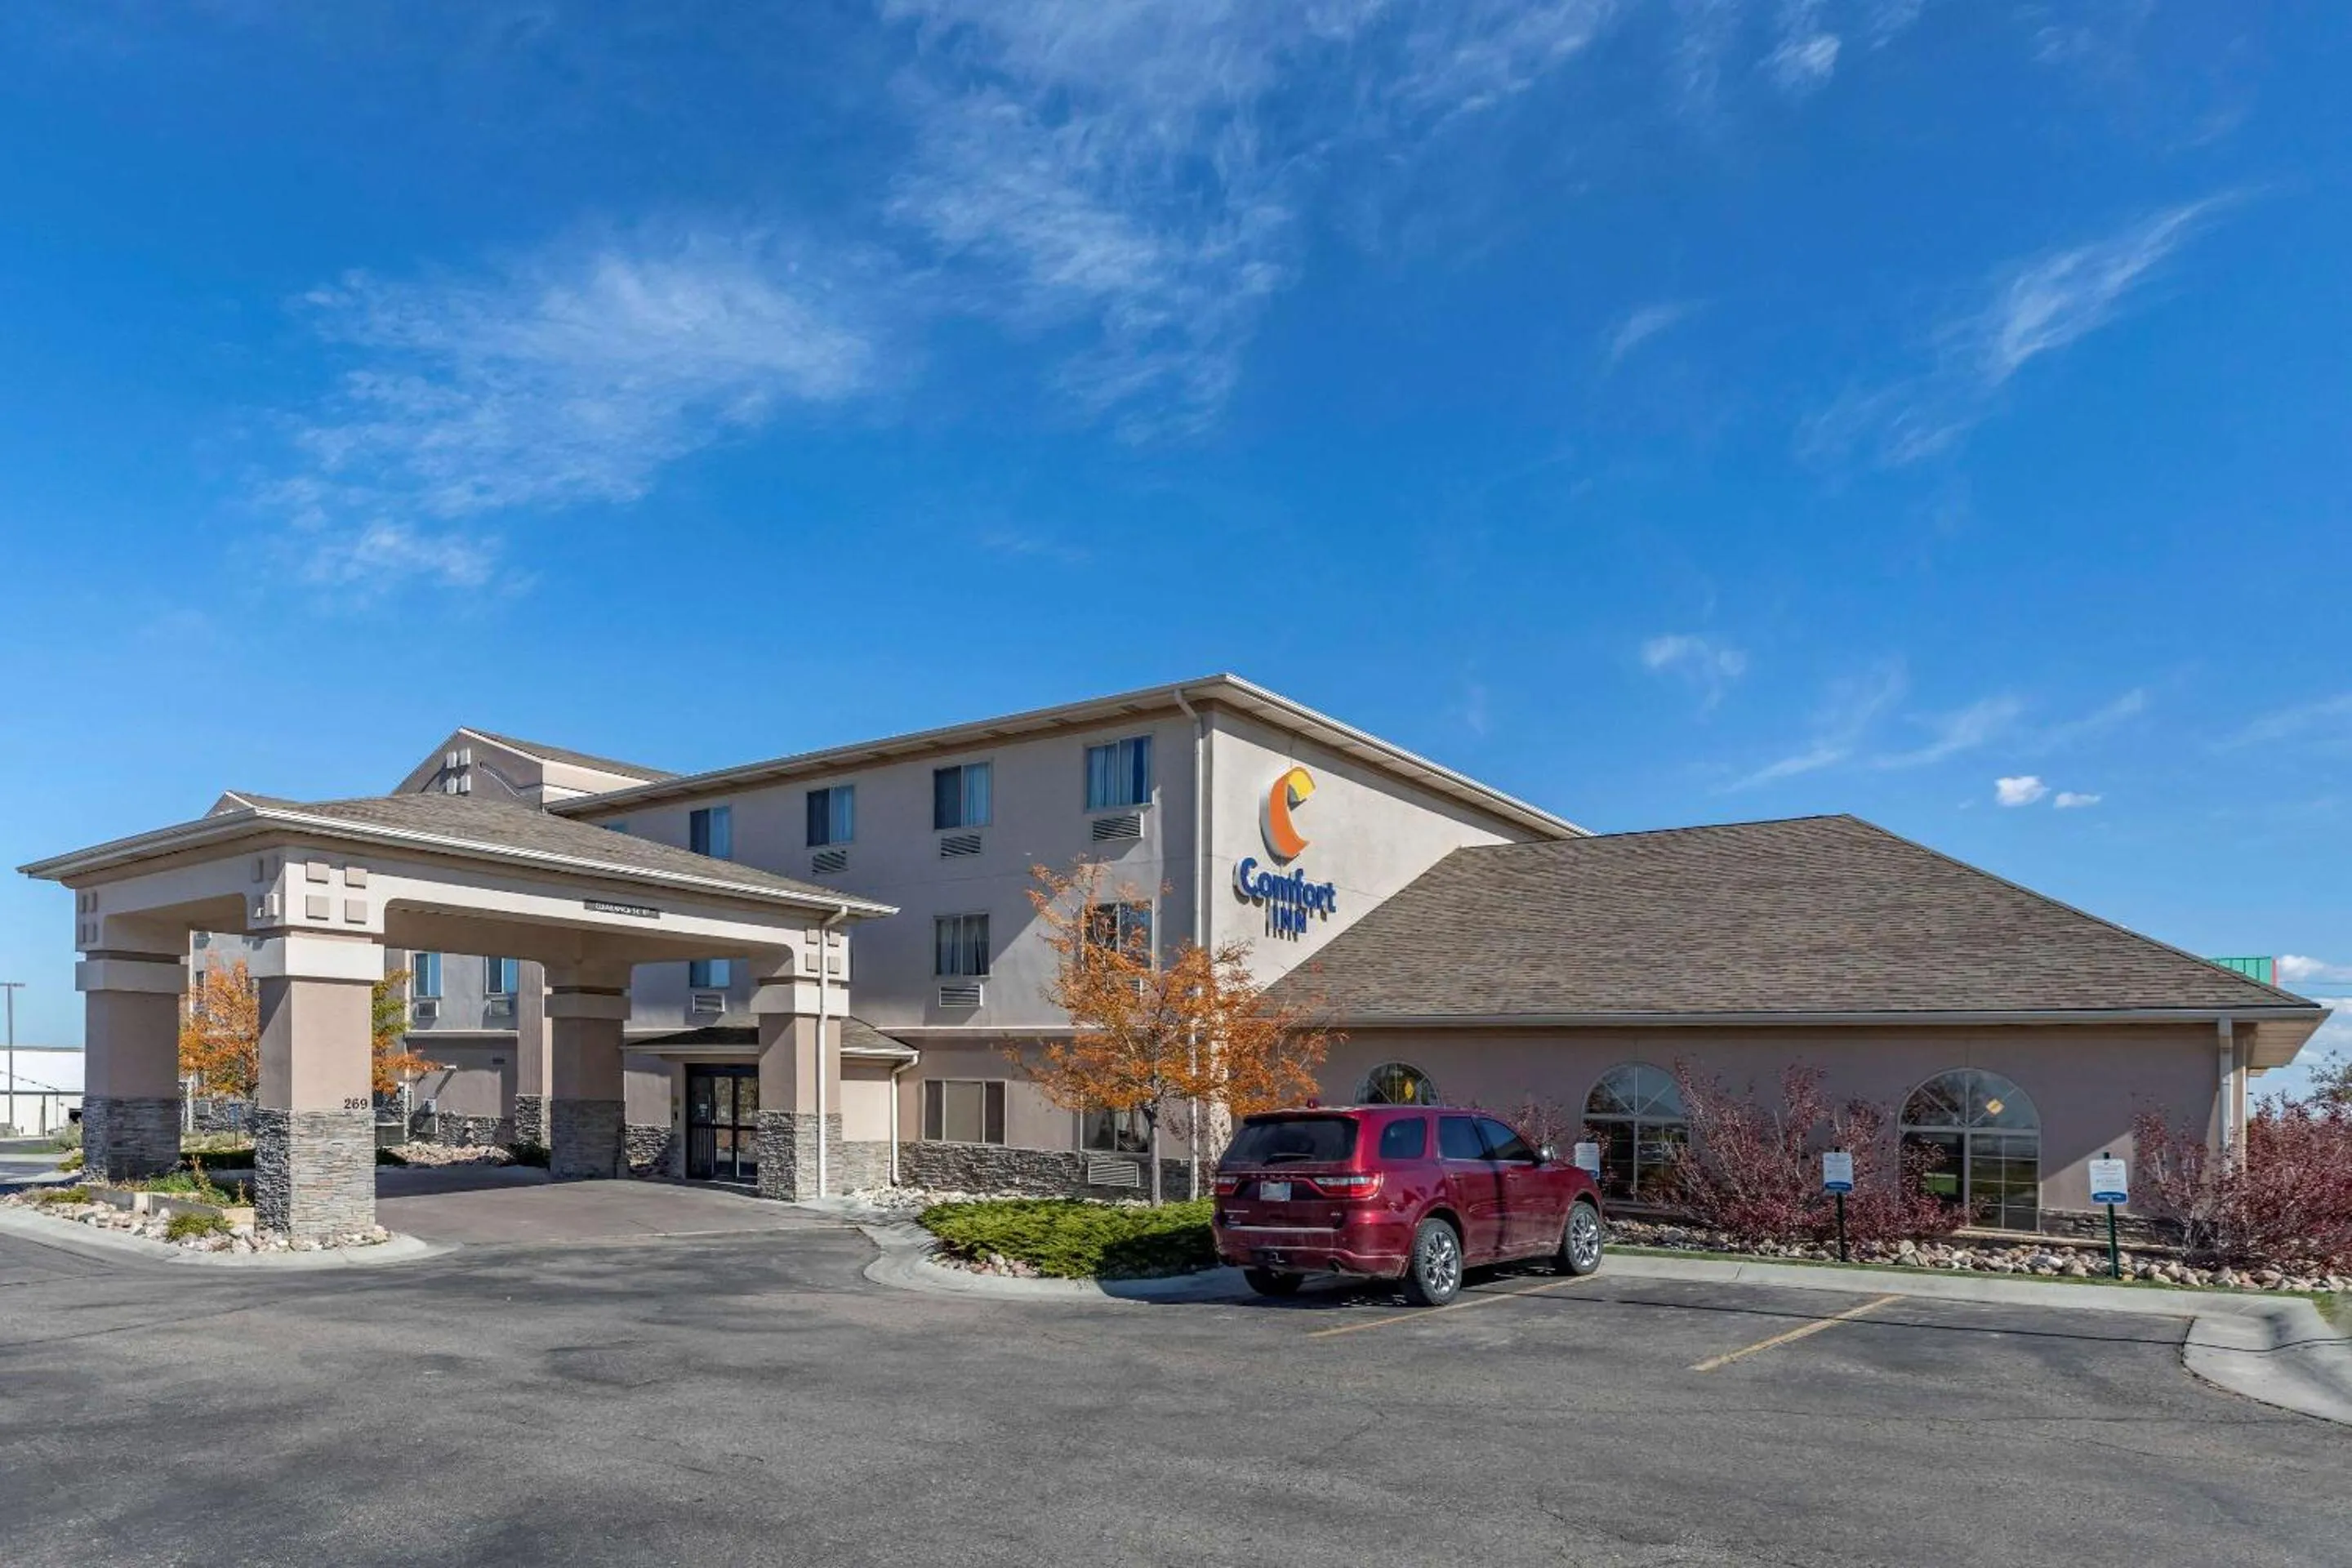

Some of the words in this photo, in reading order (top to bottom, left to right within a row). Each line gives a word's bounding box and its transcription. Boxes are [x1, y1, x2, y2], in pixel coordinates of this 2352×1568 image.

[1239, 857, 1337, 913] Comfort
[1272, 902, 1307, 933] INN
[344, 1098, 368, 1110] 269
